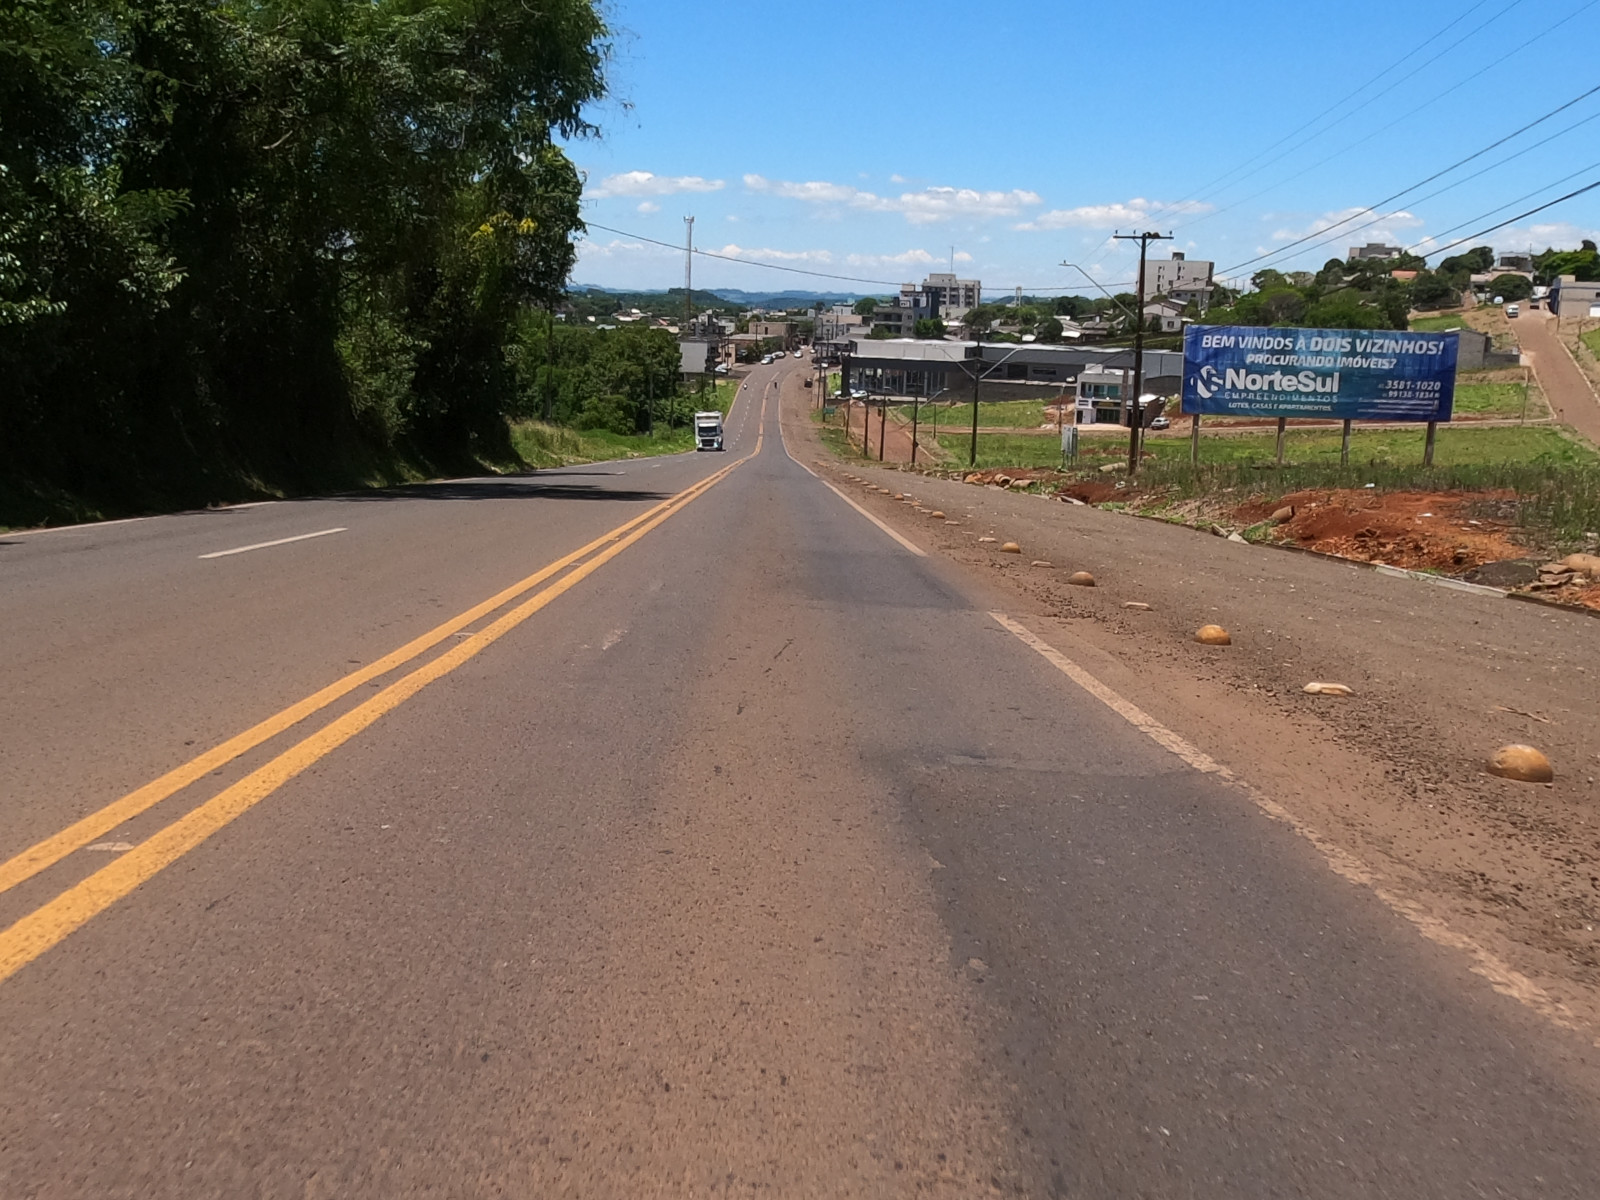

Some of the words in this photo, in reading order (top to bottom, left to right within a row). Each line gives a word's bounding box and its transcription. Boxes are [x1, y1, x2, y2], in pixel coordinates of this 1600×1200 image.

[1202, 335, 1235, 348] BEM
[1238, 336, 1293, 350] VINDOS
[1310, 337, 1352, 352] DOIS
[1355, 338, 1444, 354] VIZINHOS!
[1247, 353, 1334, 368] PROCURANDO
[1337, 355, 1397, 369] IMÓVEIS?
[1225, 368, 1340, 393] NorteSul
[1385, 380, 1441, 391] 3581-1020
